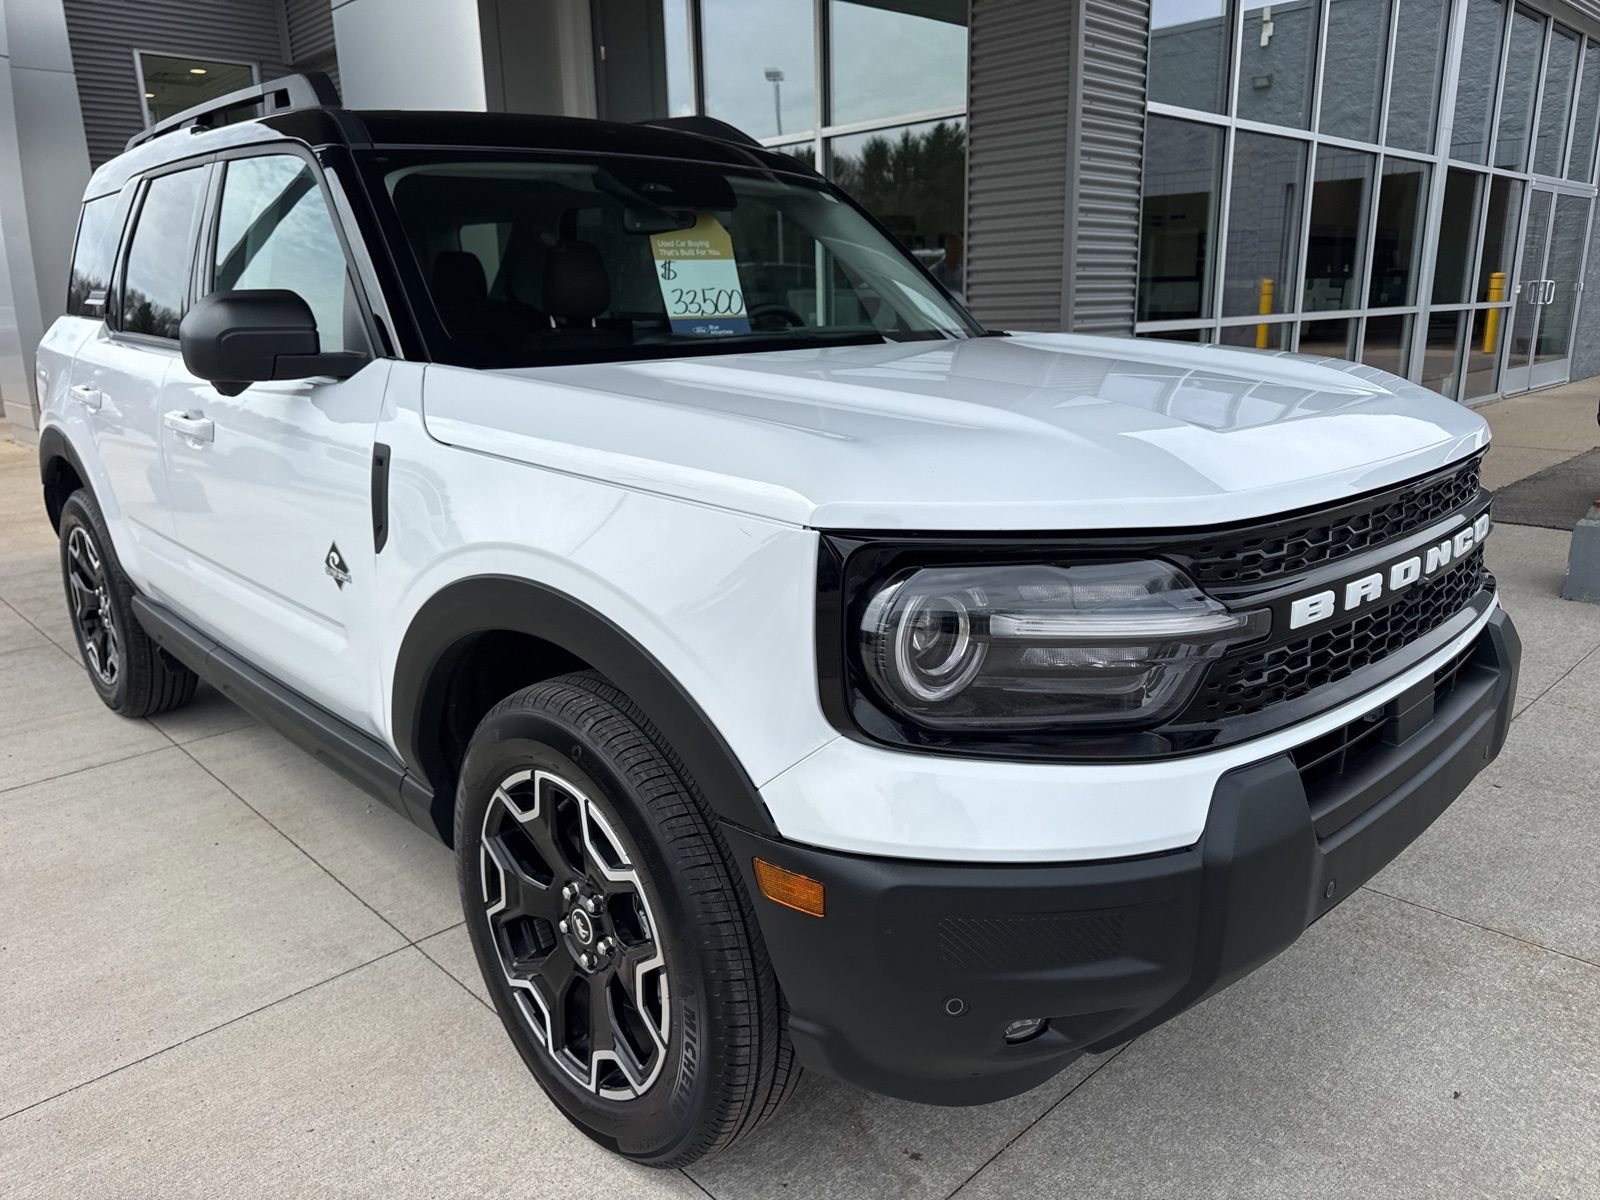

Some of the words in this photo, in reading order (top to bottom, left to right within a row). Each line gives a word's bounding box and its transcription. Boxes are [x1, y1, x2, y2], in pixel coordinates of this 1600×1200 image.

[659, 248, 680, 256] That's
[680, 248, 695, 256] Built
[695, 248, 706, 256] For
[687, 240, 710, 248] Buying
[660, 260, 678, 280] $
[671, 287, 744, 316] 33,500
[1290, 514, 1489, 629] BRONCO
